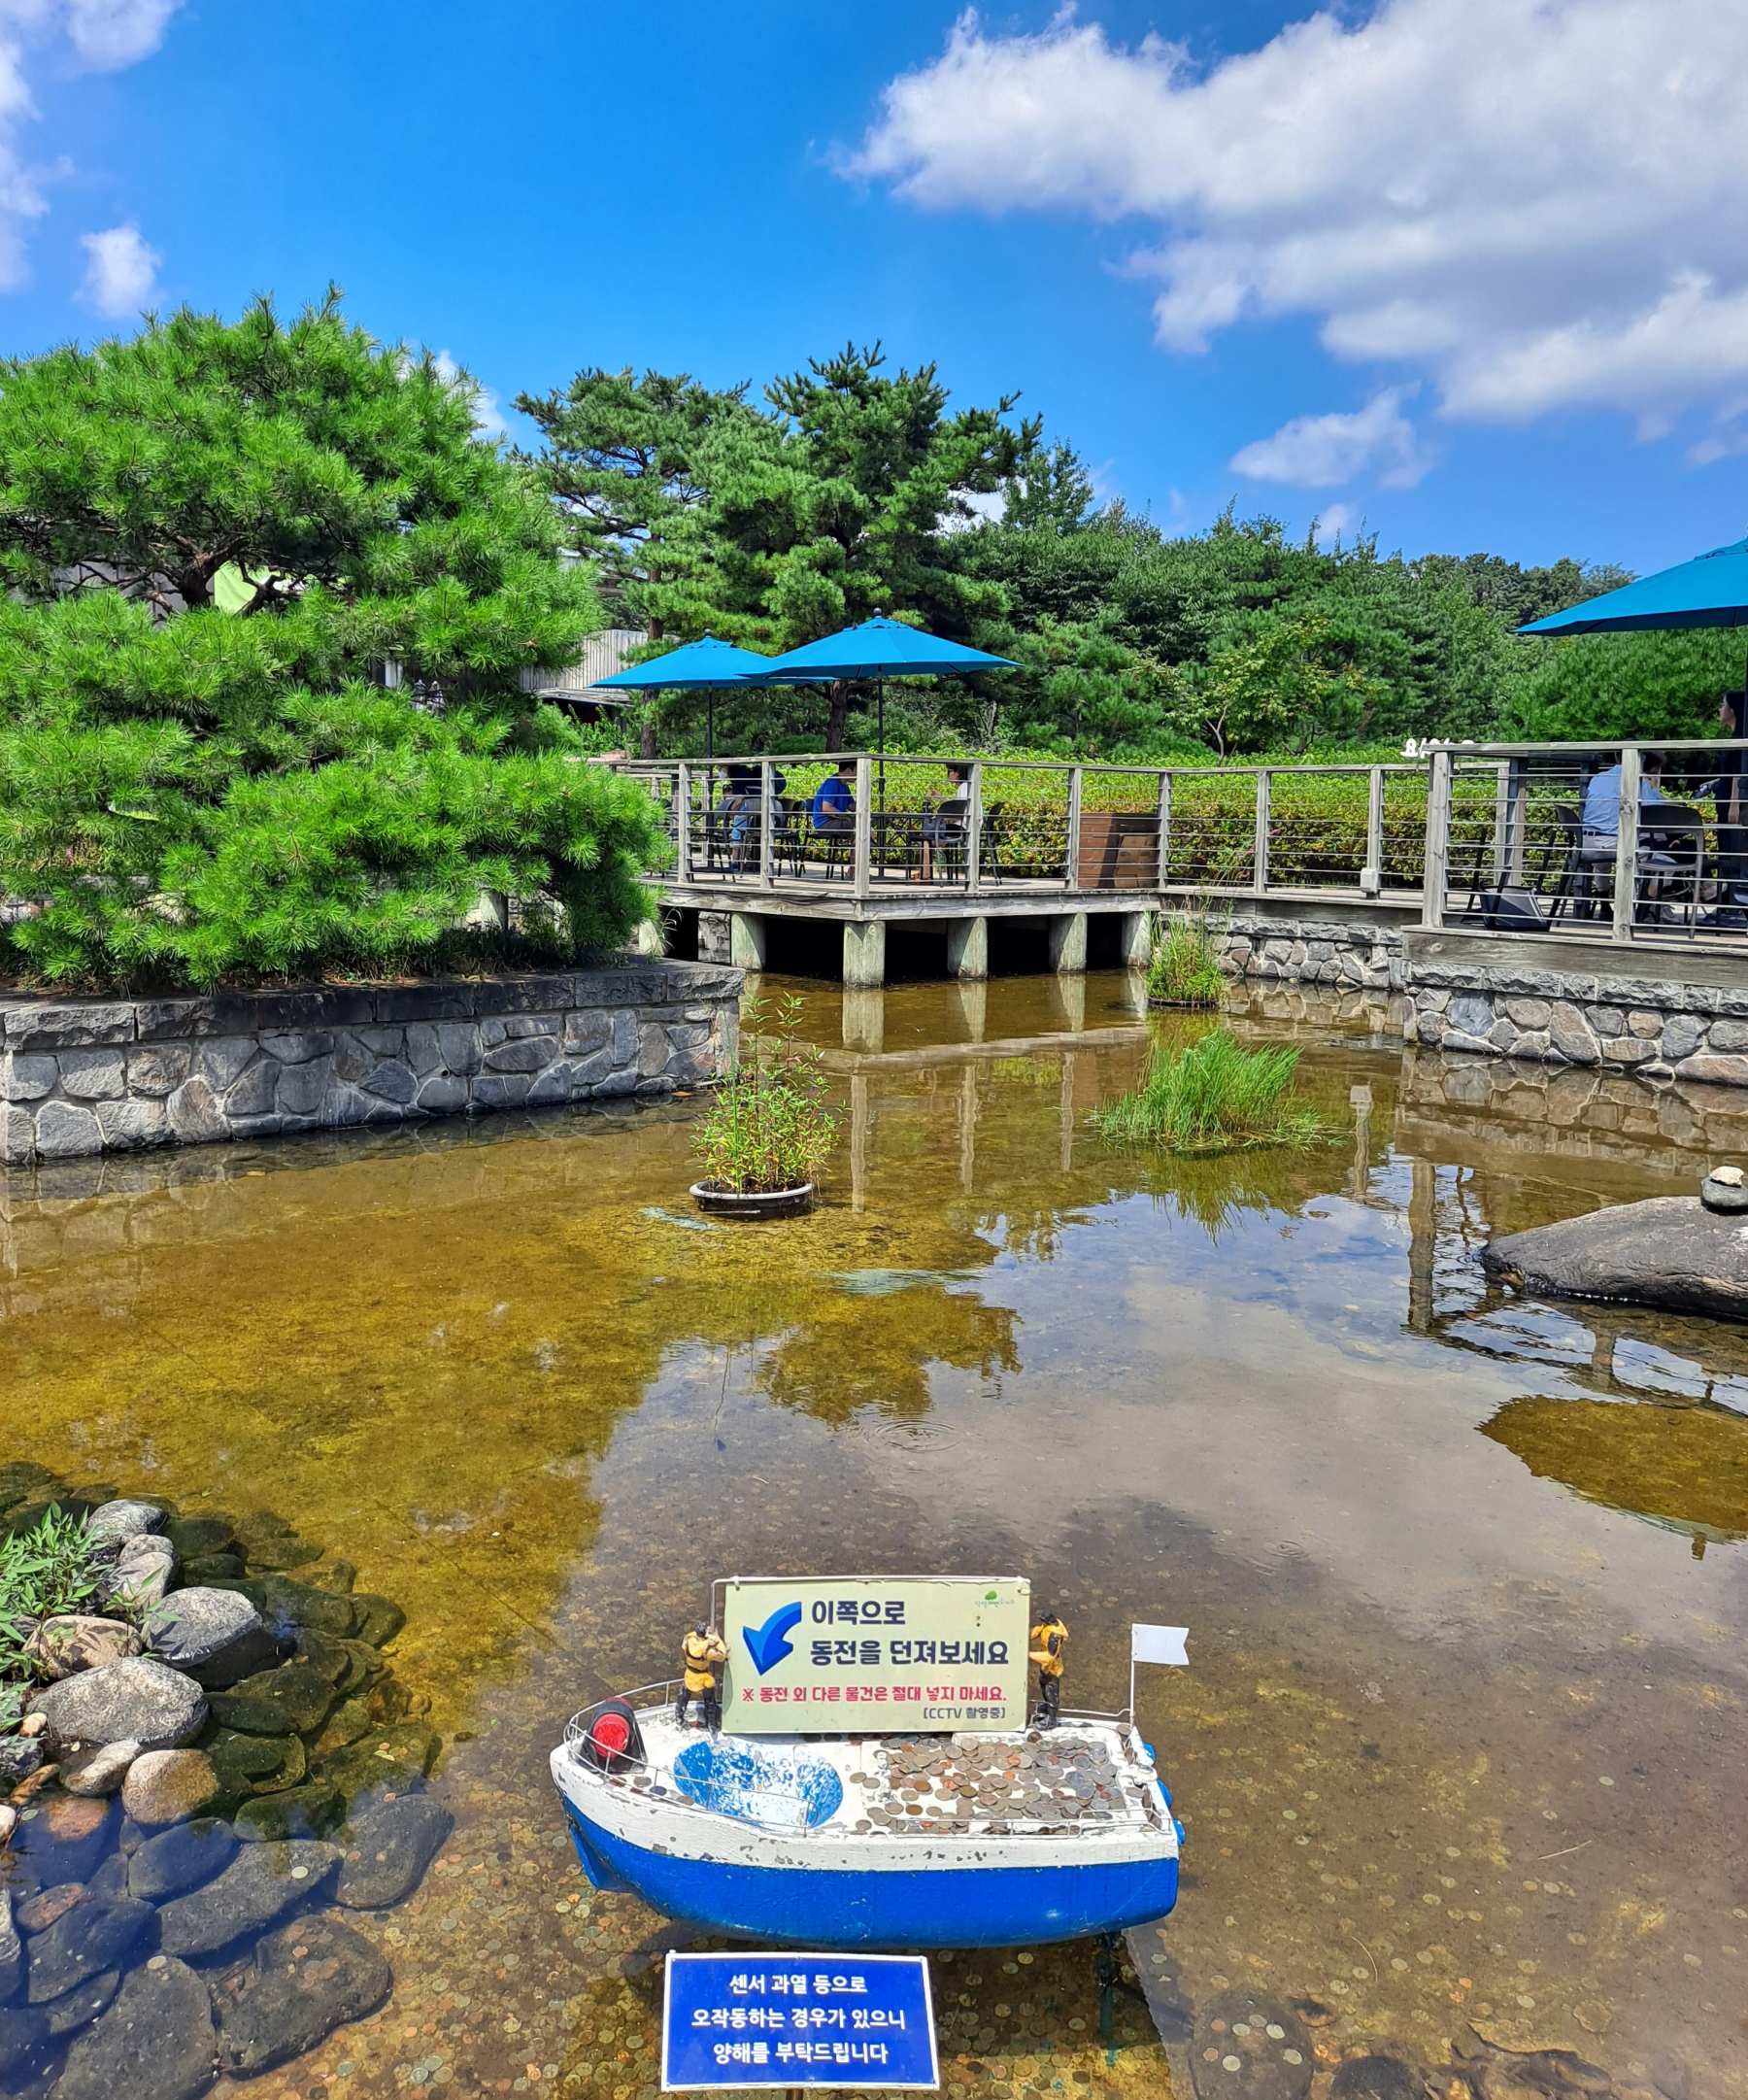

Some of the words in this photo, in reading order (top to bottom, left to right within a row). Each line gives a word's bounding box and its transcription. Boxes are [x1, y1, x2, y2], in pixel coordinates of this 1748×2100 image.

[812, 1601, 905, 1625] 이쪽으로
[811, 1641, 881, 1666] 동전을
[890, 1640, 1009, 1665] 던져보세요
[760, 1687, 788, 1702] 동전
[793, 1687, 806, 1701] 외
[813, 1687, 840, 1701] 다른
[846, 1687, 888, 1701] 물건은
[892, 1686, 921, 1701] 절대
[926, 1687, 954, 1701] 넣지
[959, 1686, 1006, 1701] 마세요.
[729, 1975, 765, 1994] 센서
[771, 1975, 807, 1994] 과열
[813, 1975, 867, 1994] 등으로
[691, 2008, 785, 2029] 오작동하는
[791, 2008, 846, 2028] 경우가
[852, 2009, 905, 2030] 있으니
[714, 2043, 769, 2064] 양해를
[776, 2042, 889, 2064] 부탁드립니다
